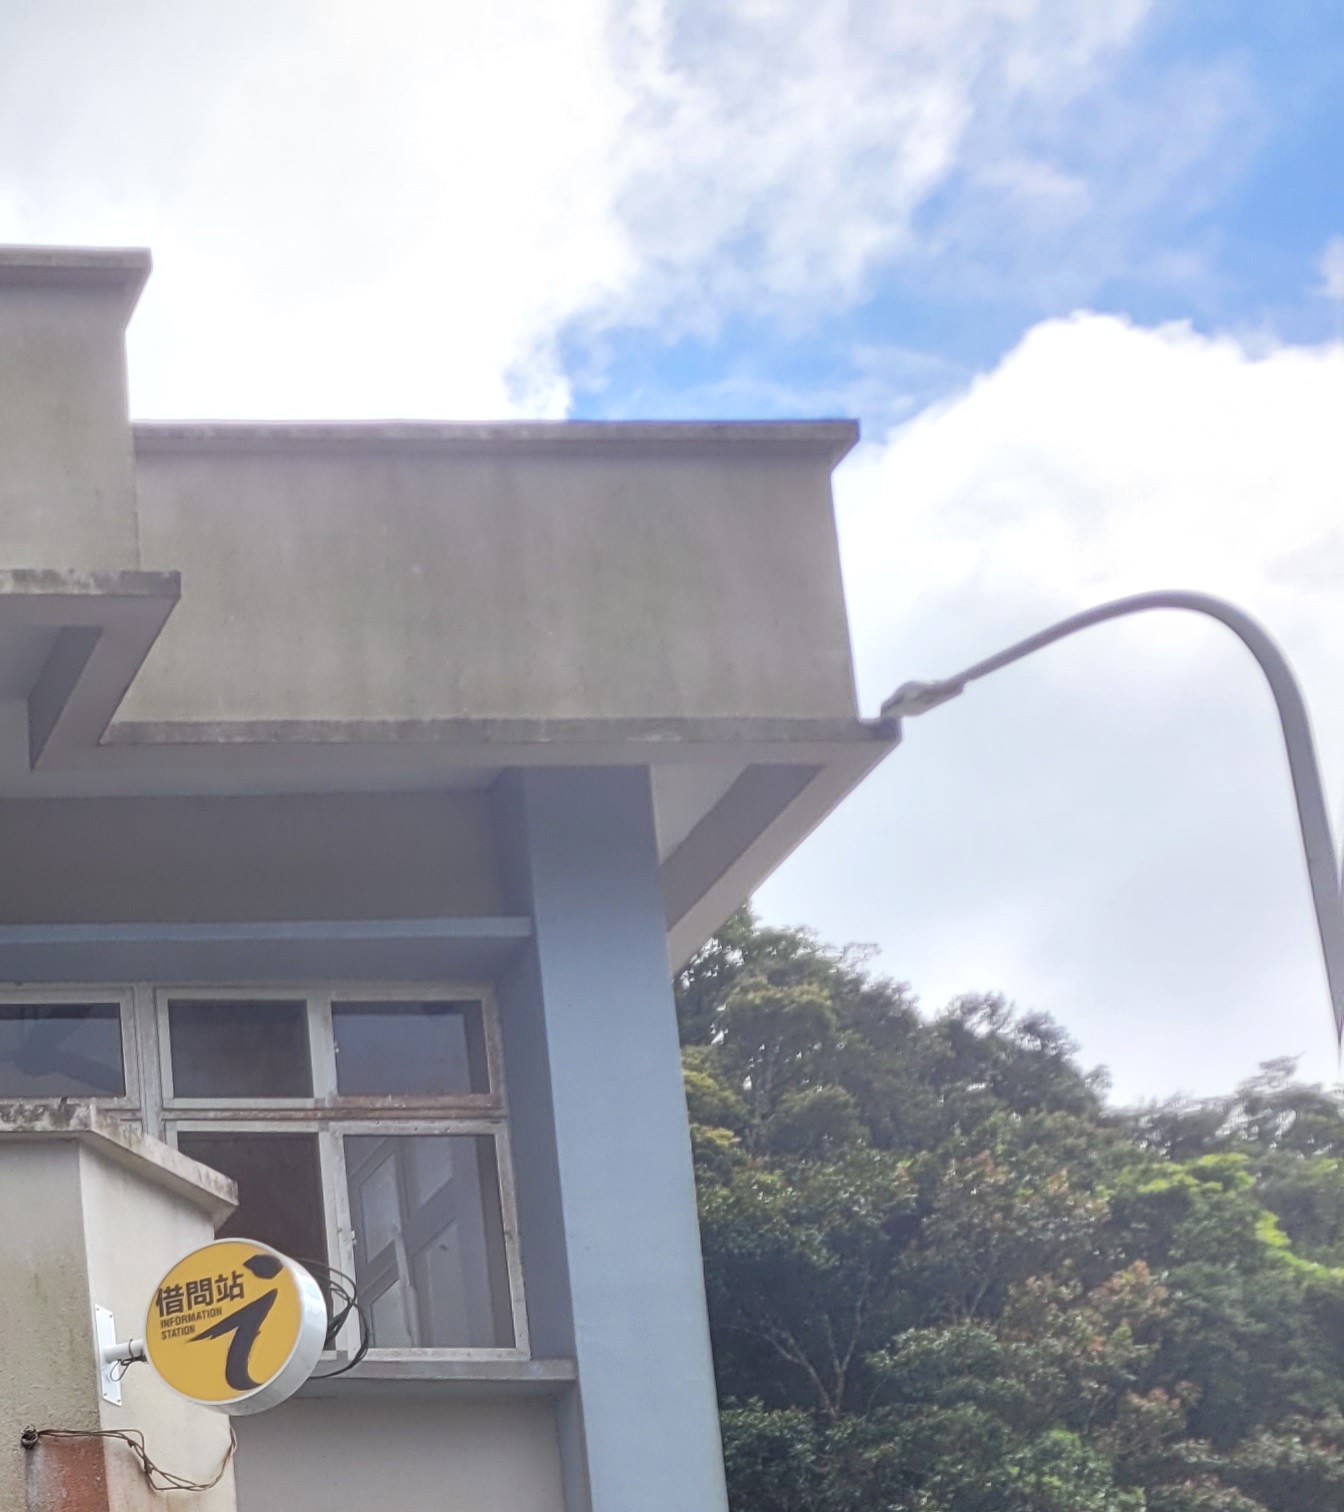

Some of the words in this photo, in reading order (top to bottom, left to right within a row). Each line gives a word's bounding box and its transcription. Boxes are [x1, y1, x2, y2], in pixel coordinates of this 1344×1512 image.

[156, 1270, 244, 1317] 借問站
[160, 1307, 222, 1328] INFORMATION
[161, 1325, 195, 1340] STATION
